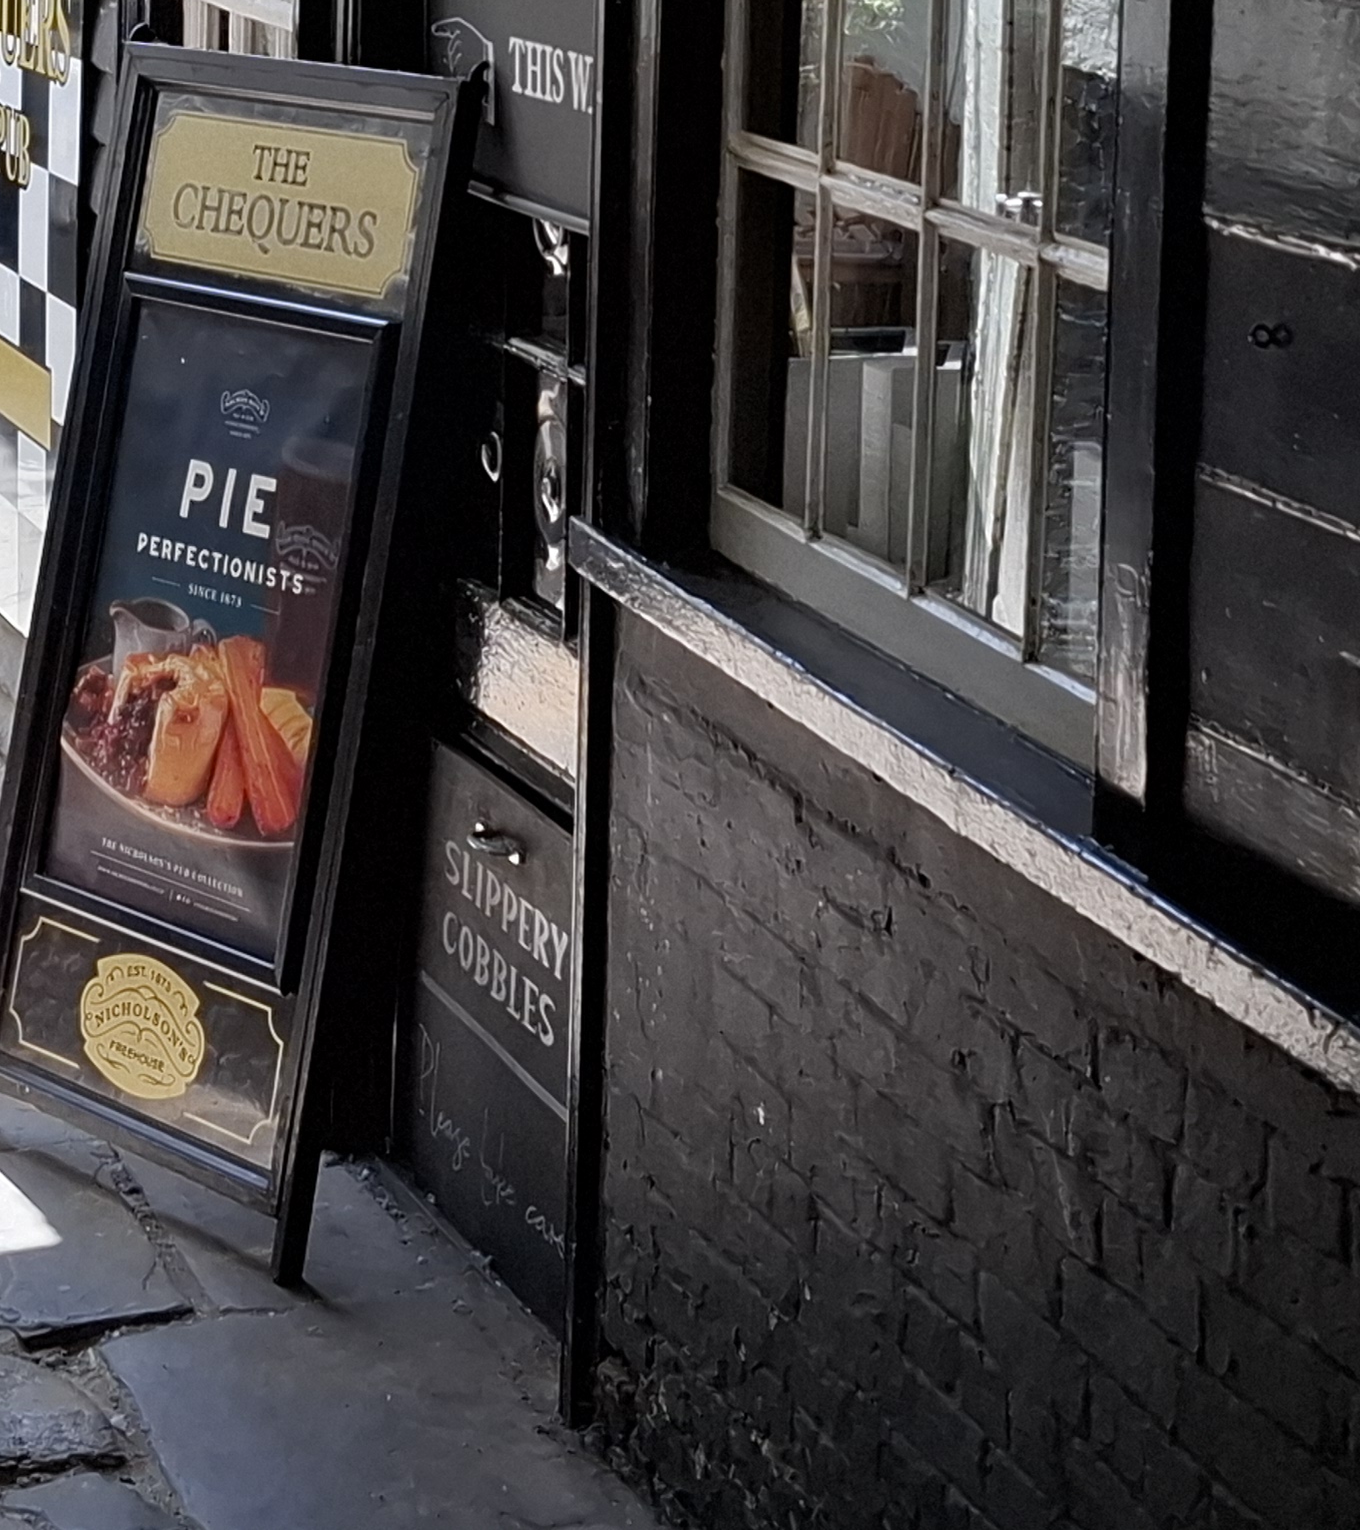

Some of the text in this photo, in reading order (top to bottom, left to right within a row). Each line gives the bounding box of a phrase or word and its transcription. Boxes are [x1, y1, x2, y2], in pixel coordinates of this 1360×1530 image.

[508, 36, 565, 104] THIS
[252, 144, 311, 187] THE
[172, 182, 378, 259] CHEQUERS
[179, 458, 277, 540] PIE
[136, 532, 304, 595] PERFECTIONISTS
[188, 583, 217, 602] SINCE
[444, 839, 569, 981] SLIPPERY
[442, 911, 557, 1047] COBBLES
[94, 1001, 189, 1063] NICHOLSON'S
